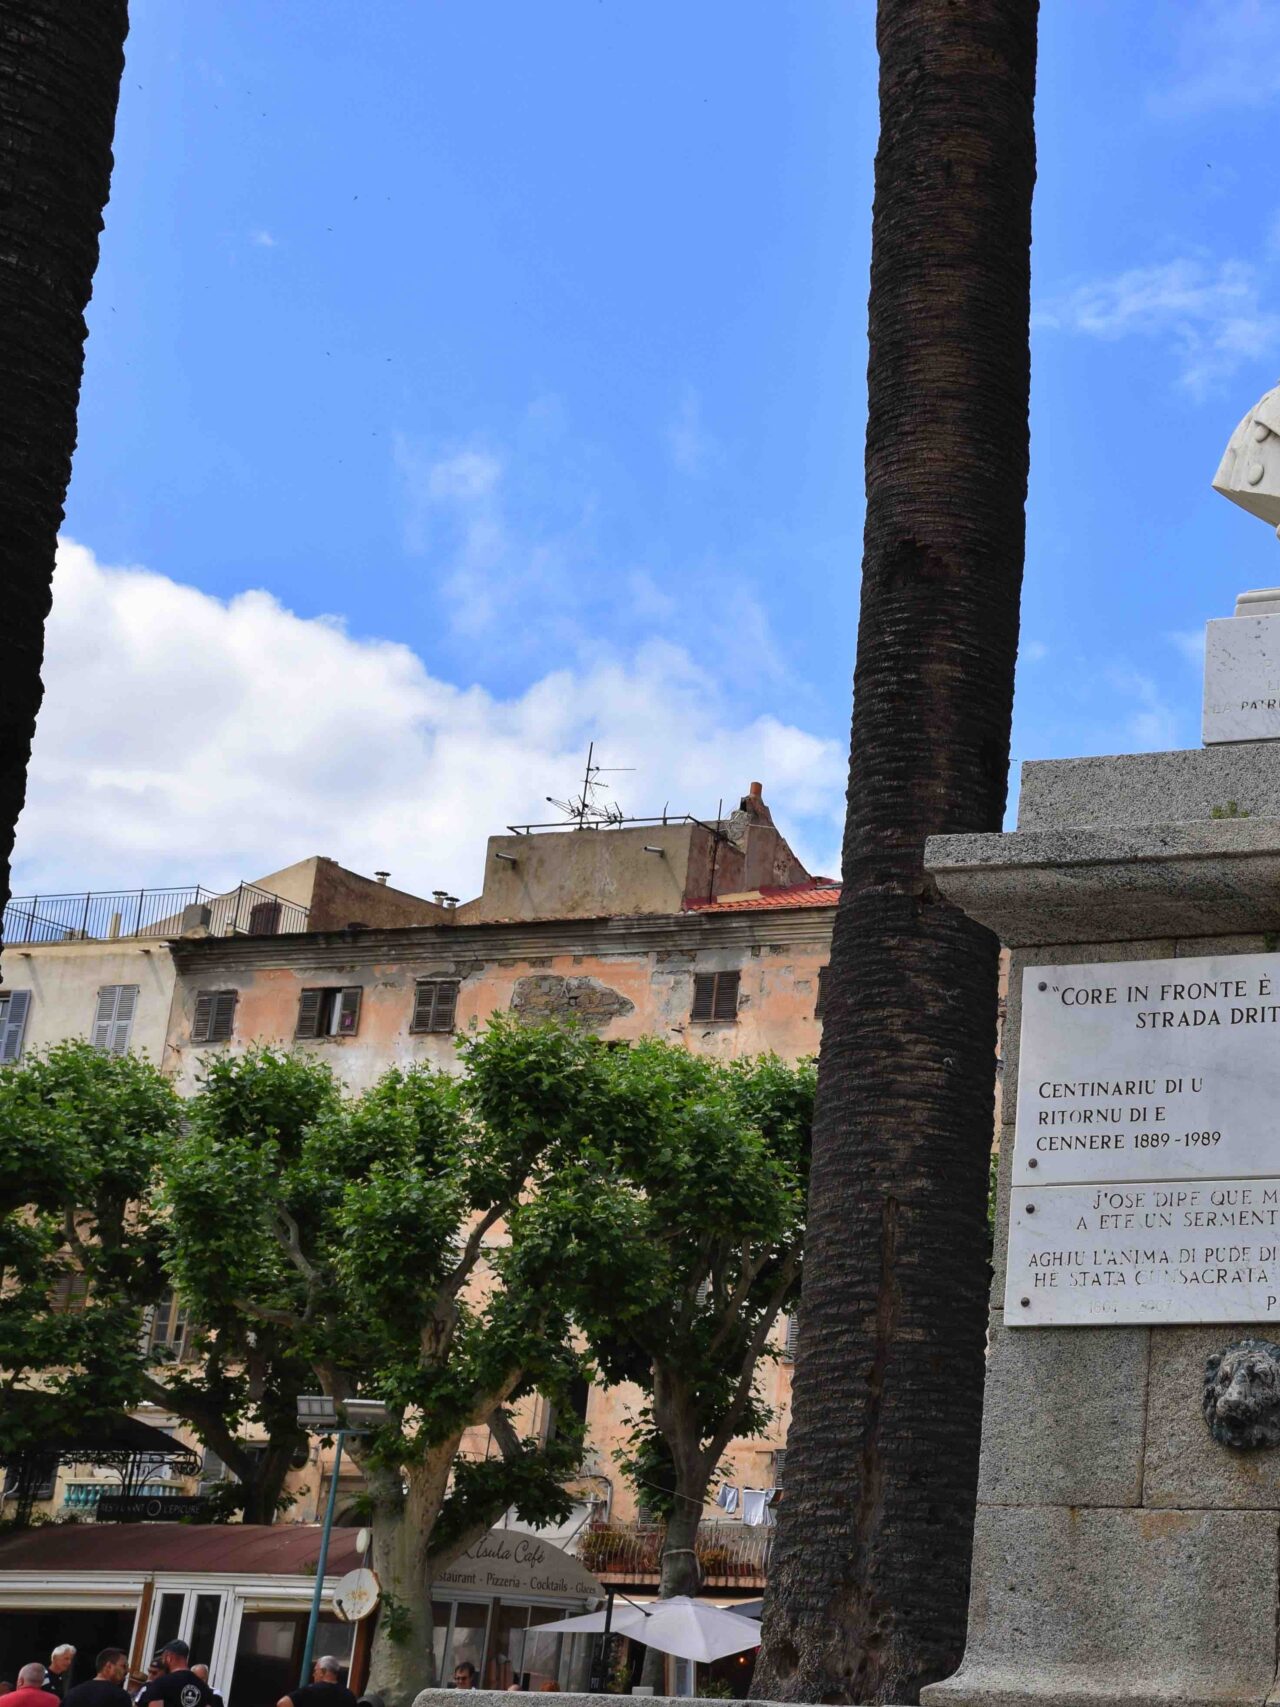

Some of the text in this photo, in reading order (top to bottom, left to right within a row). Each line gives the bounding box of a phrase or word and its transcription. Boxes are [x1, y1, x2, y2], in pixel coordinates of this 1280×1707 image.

[1127, 986, 1149, 1002] IN
[1160, 980, 1248, 1001] FRONTE
[1258, 973, 1272, 996] È
[1135, 1009, 1221, 1029] STRADA
[1038, 1078, 1203, 1099] CENTINARIU DI U
[1038, 1106, 1166, 1125] RITORNU DI E
[1036, 1134, 1125, 1151] CENNERE
[1092, 1189, 1145, 1210] J'OSE
[1210, 1189, 1253, 1206] QUE
[1076, 1216, 1088, 1231] A
[1145, 1212, 1173, 1229] UN
[1183, 1209, 1279, 1228] SERMENT
[1179, 1248, 1196, 1264] DI
[1259, 1246, 1277, 1262] DI
[1069, 1270, 1126, 1287] STATA
[514, 1539, 545, 1568] Café
[486, 1572, 520, 1588] Pizzeria
[530, 1576, 568, 1592] Cocktails
